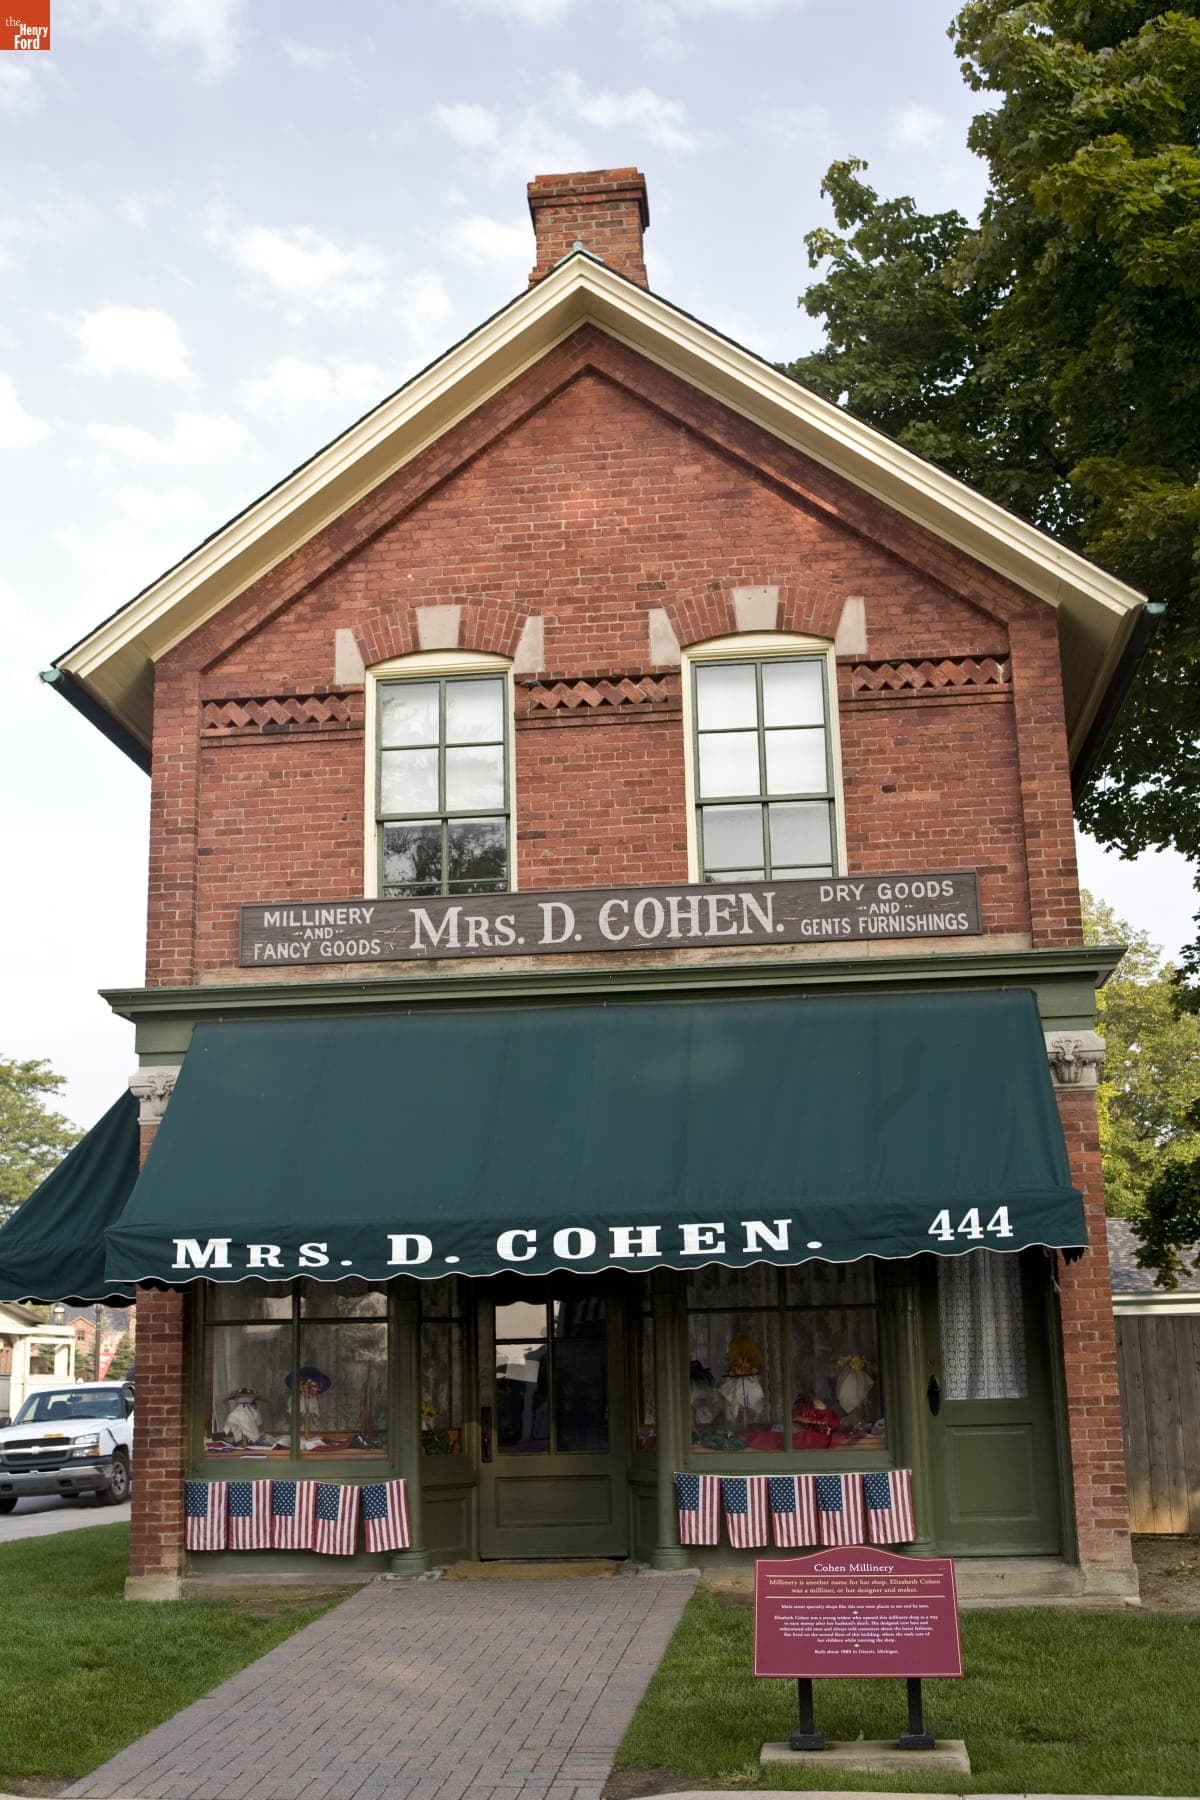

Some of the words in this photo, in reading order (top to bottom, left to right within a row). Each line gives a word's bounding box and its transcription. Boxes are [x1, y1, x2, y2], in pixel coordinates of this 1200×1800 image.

[820, 884, 865, 902] DRY
[877, 880, 955, 900] GOODS
[263, 907, 374, 928] MILLINERY
[537, 902, 583, 944] D.
[598, 891, 785, 941] COHEN.
[800, 917, 851, 935] GENTS
[858, 912, 969, 933] FURNISHINGS
[254, 942, 311, 960] FANCY
[320, 939, 381, 957] GOODS
[386, 1233, 460, 1265] D.
[496, 1218, 823, 1263] COHEN.
[927, 1205, 1014, 1241] 444
[814, 1563, 846, 1572] Cohen
[849, 1562, 894, 1574] Millinery
